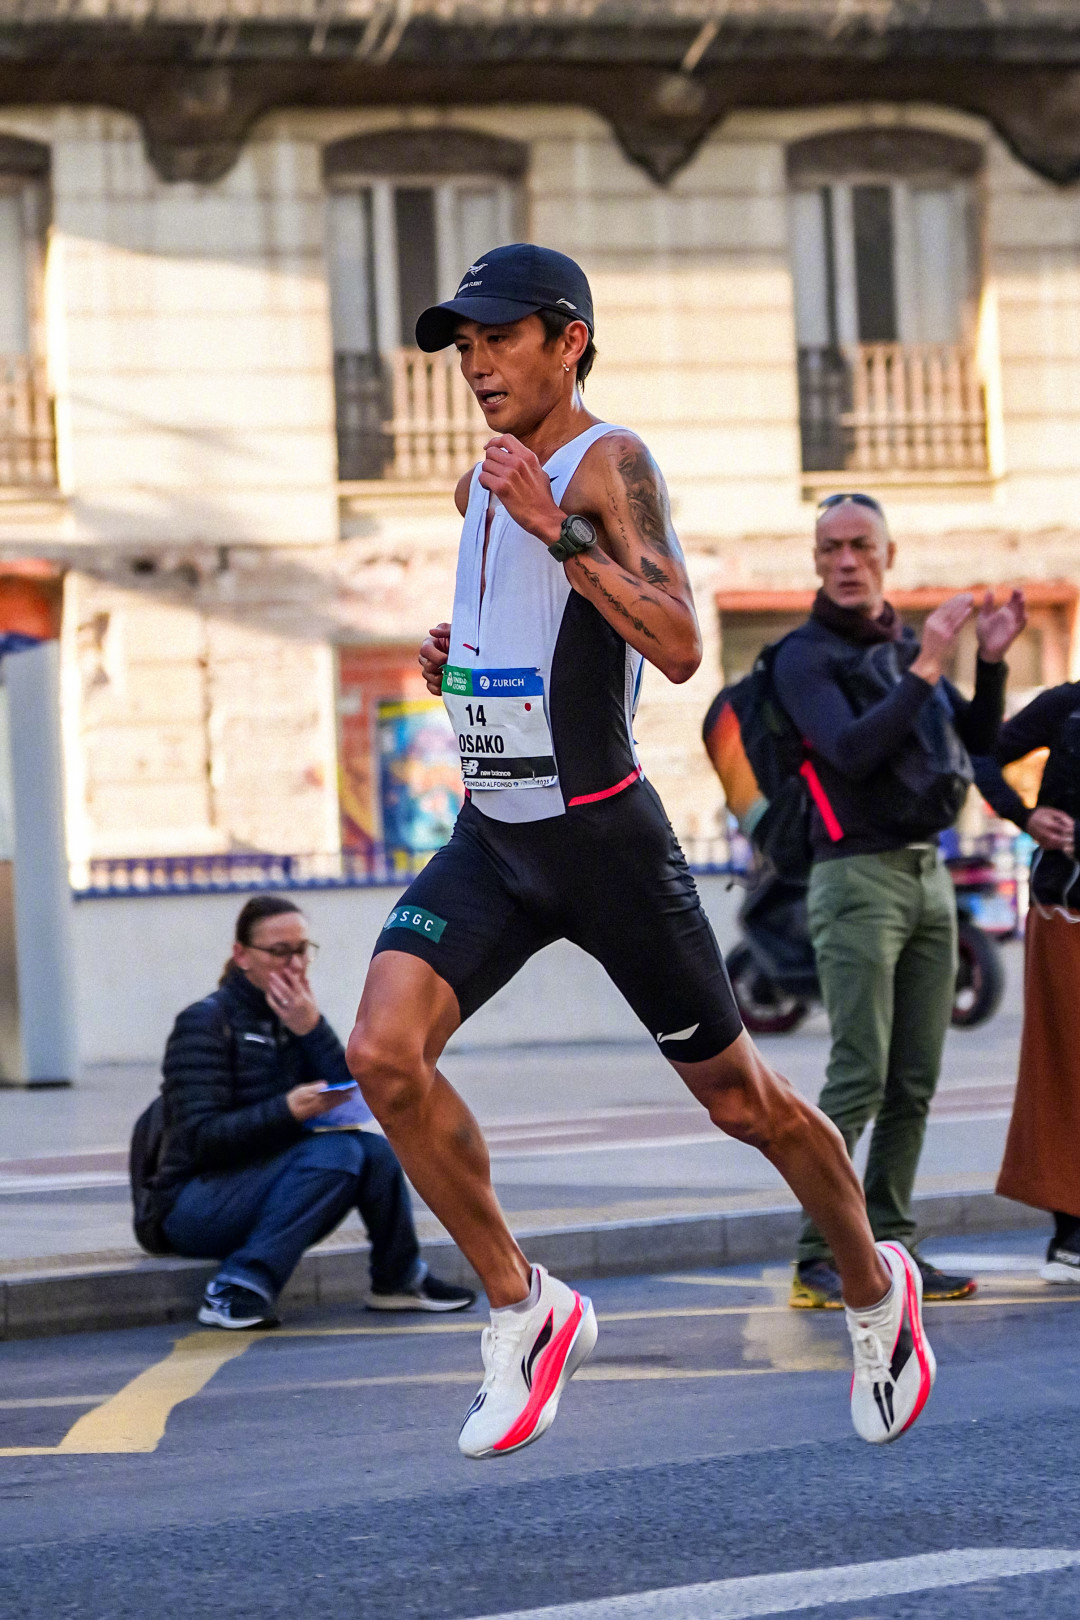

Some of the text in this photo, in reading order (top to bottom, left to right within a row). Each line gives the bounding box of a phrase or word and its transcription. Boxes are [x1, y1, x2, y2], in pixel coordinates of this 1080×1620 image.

[492, 678, 524, 687] ZURICH
[465, 704, 486, 726] 14
[459, 734, 504, 753] OSAKO
[400, 911, 433, 931] SGC
